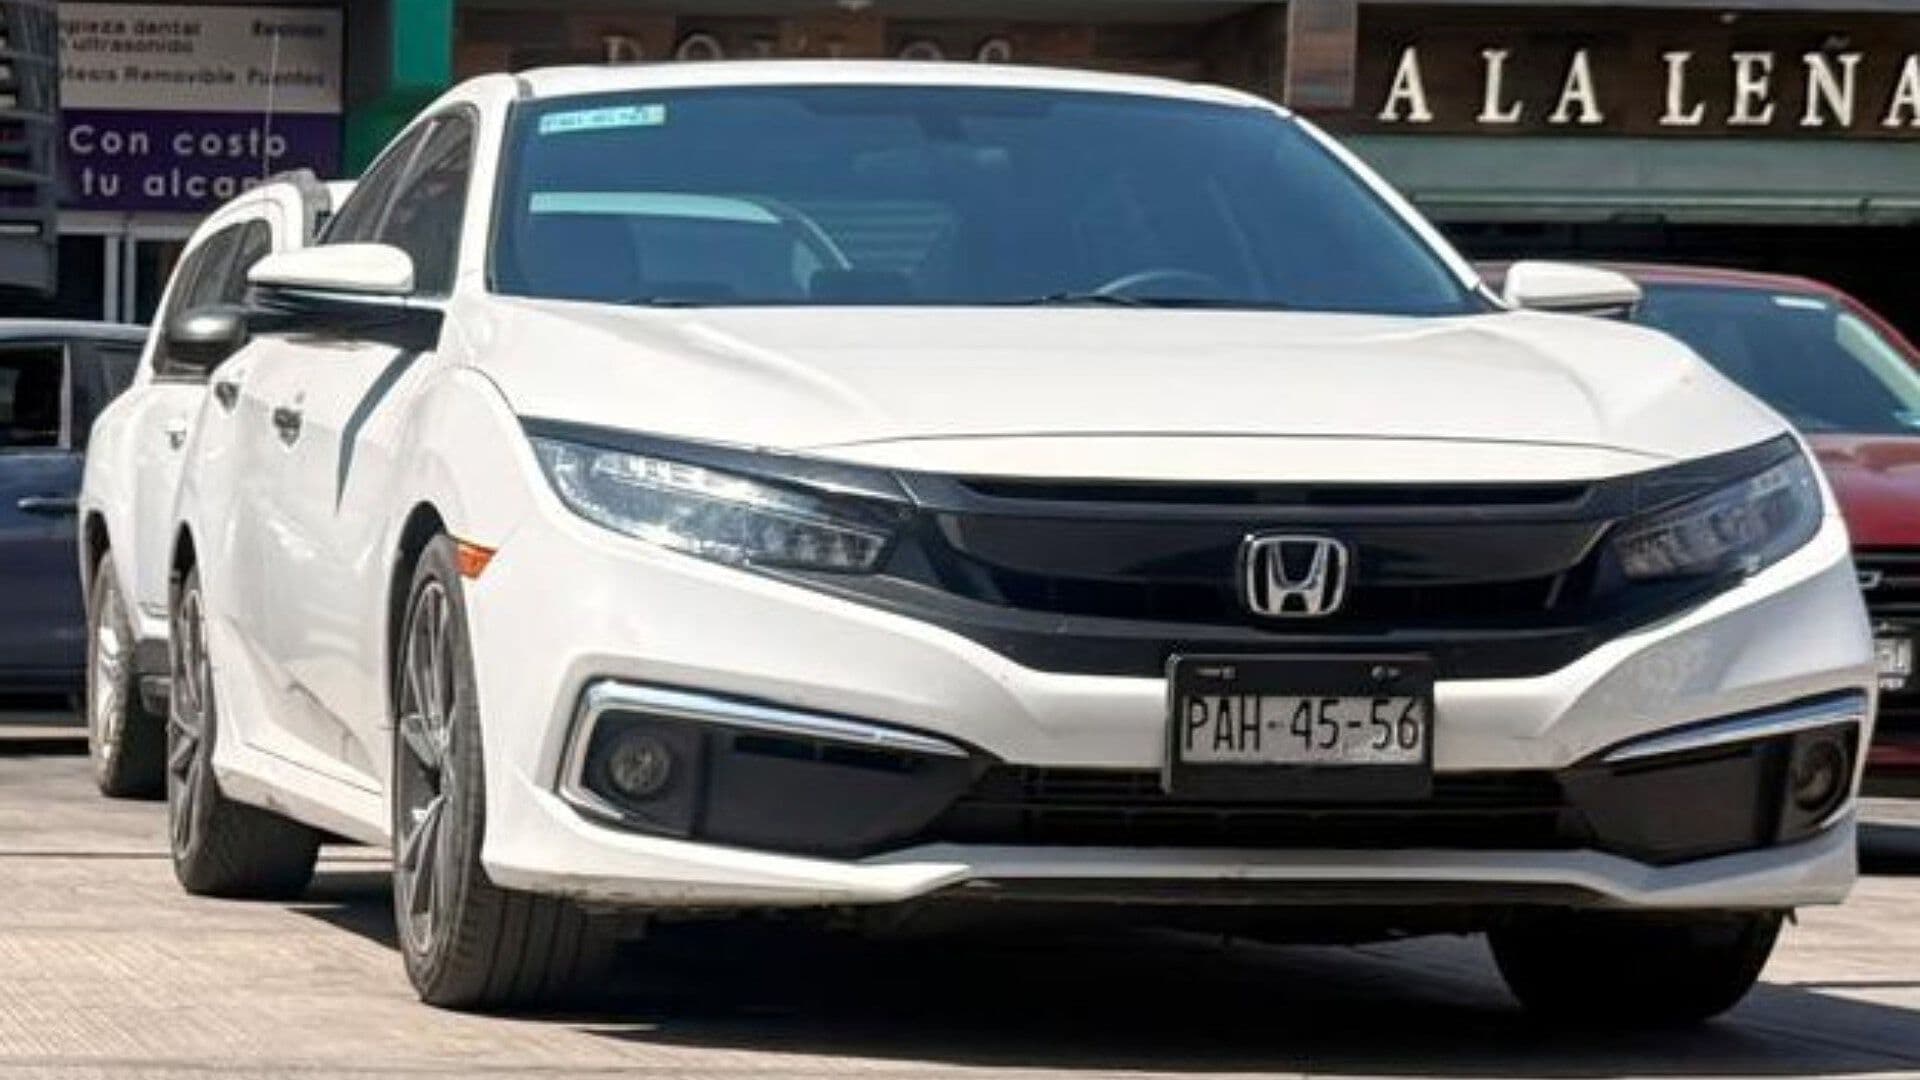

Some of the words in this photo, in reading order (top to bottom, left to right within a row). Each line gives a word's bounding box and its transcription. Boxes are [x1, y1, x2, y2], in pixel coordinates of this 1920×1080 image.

[1378, 47, 1432, 122] A
[1477, 48, 1602, 123] LA
[68, 124, 149, 154] Con
[172, 128, 287, 157] costo
[82, 167, 120, 197] tu
[1186, 697, 1420, 752] PAH-45-56
